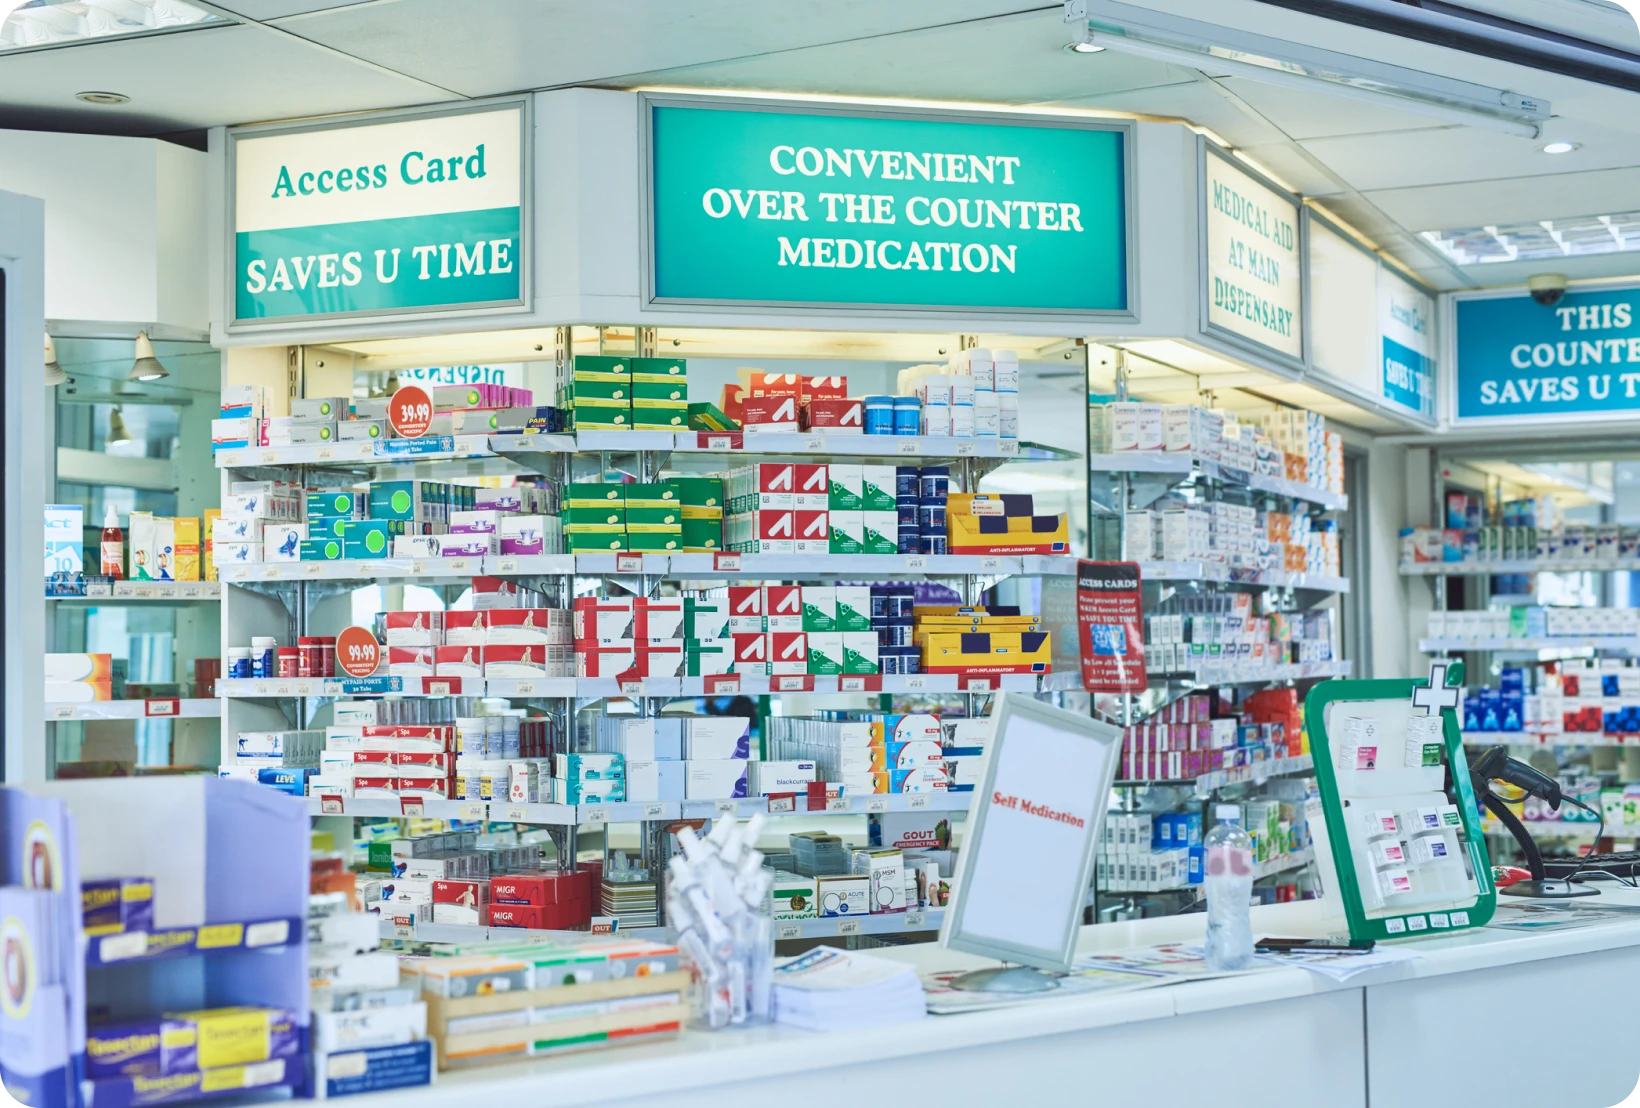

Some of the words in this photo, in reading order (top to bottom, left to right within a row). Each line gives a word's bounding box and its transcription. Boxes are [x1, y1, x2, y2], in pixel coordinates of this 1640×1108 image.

[769, 145, 1021, 185] CONVENIENT
[271, 164, 387, 199] Access
[400, 143, 487, 186] Card
[702, 188, 809, 222] OVER
[818, 192, 896, 225] THE
[905, 196, 1084, 232] COUNTER
[1213, 179, 1269, 234] MEDICAL
[1273, 218, 1294, 252] AID
[777, 236, 1018, 274] MEDICATION
[246, 251, 362, 294] SAVES
[374, 248, 401, 284] U
[412, 238, 513, 280] TIME
[1228, 236, 1246, 270] AT
[1248, 246, 1280, 287] MAIN
[1213, 276, 1293, 338] DISPENSARY
[1555, 302, 1632, 331] THIS
[1480, 376, 1580, 405] SAVES
[1588, 374, 1611, 400] U
[401, 403, 430, 423] 39.99
[398, 422, 427, 430] CONSISTENT
[54, 556, 73, 573] 10
[1079, 577, 1103, 588] ACCESS
[1104, 579, 1138, 588] CARDS
[1119, 605, 1136, 613] Card
[348, 644, 375, 661] 99.99
[1083, 658, 1091, 666] By
[366, 727, 376, 736] Spa
[400, 728, 410, 737] Spa
[357, 753, 367, 762] Spa
[402, 754, 412, 763] Spa
[358, 779, 368, 788] Spa
[404, 779, 413, 788] Spa
[992, 791, 1018, 809] Self
[1019, 798, 1085, 828] Medication
[903, 830, 934, 840] GOUT
[895, 840, 926, 848] EMERGENCY
[437, 882, 448, 892] Spa
[496, 885, 516, 894] MIGR
[493, 911, 513, 920] MIGR
[396, 917, 409, 925] OUT
